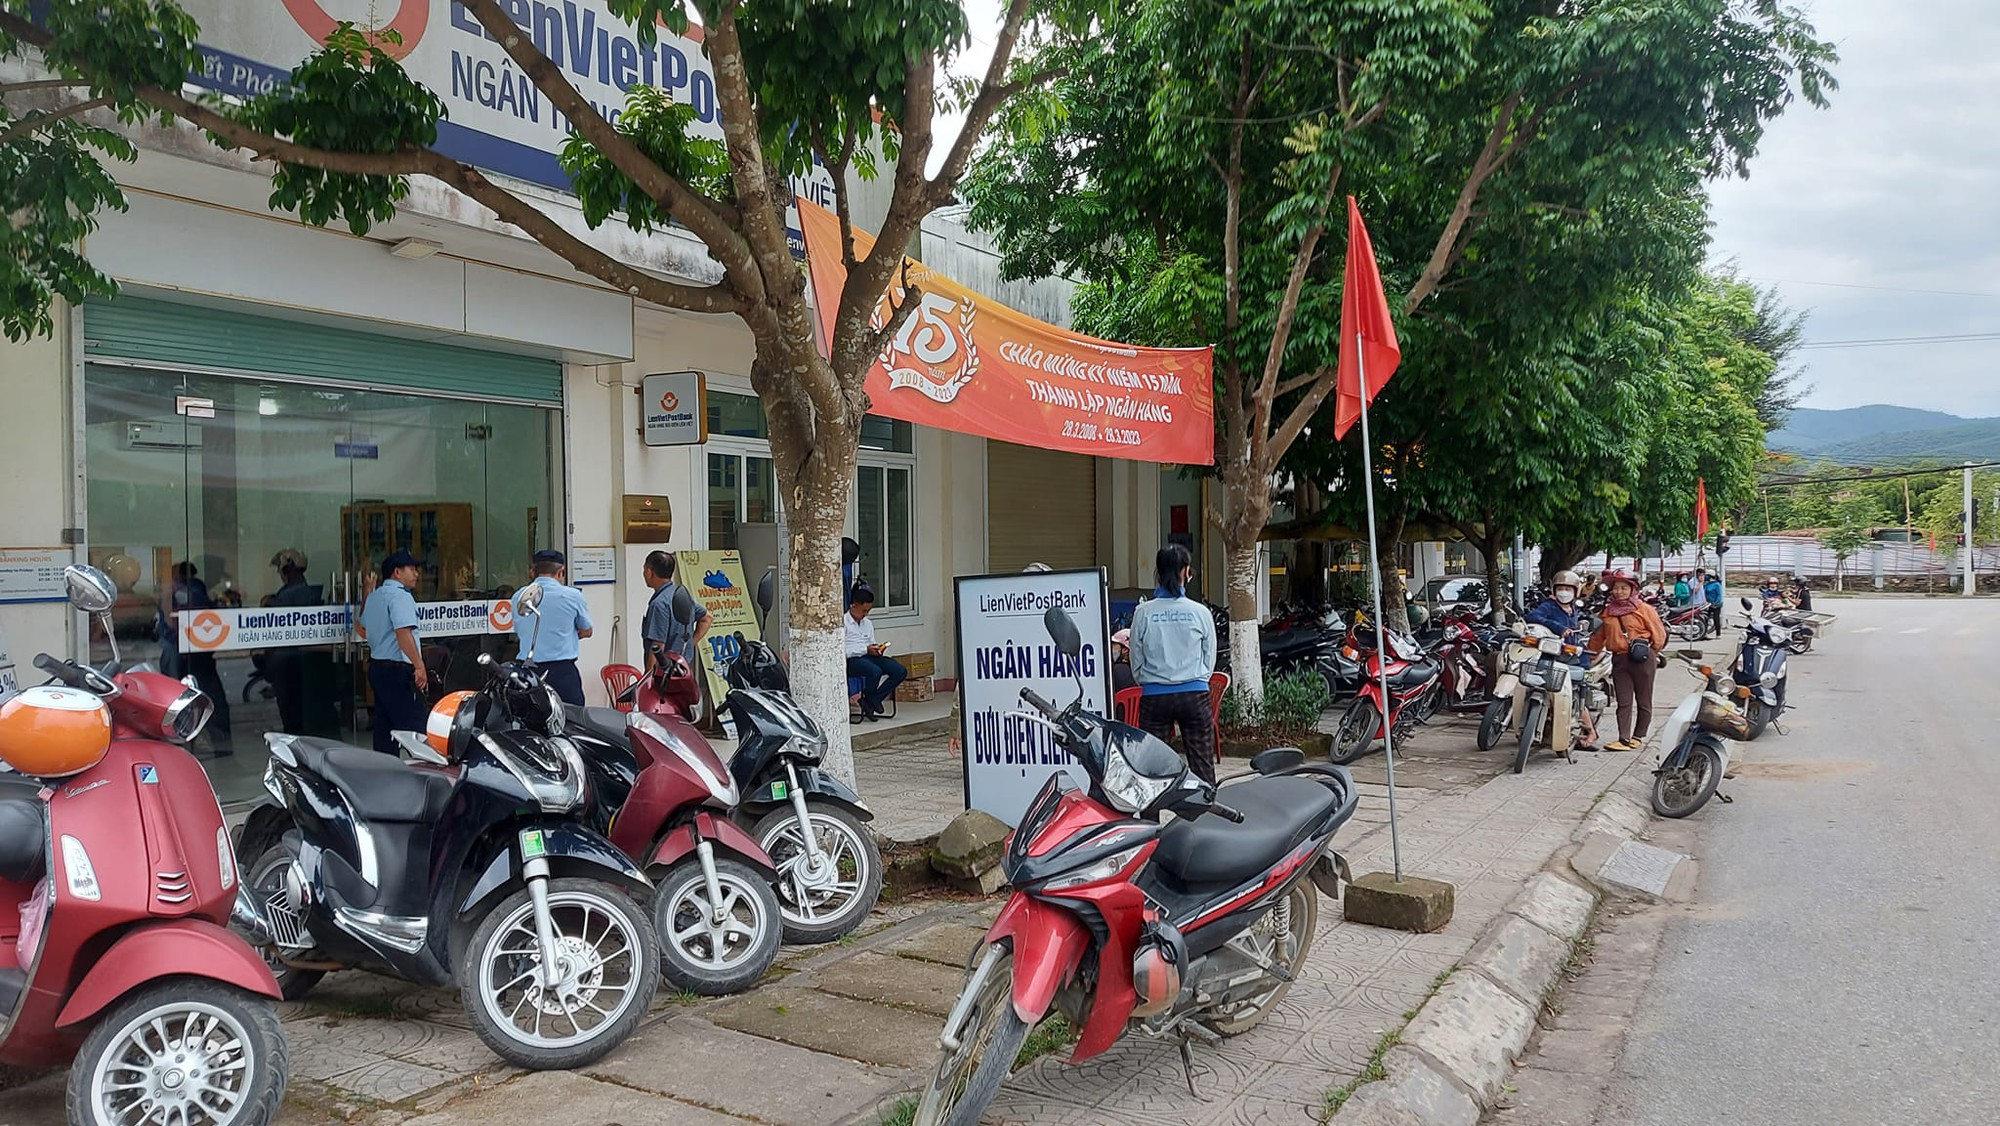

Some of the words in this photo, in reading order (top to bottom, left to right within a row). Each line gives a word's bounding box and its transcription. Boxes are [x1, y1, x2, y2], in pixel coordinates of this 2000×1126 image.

[451, 49, 540, 124] NGÂN
[898, 372, 925, 388] 2008
[933, 384, 954, 401] 2023
[998, 340, 1041, 371] CHÀO
[1042, 352, 1087, 381] MỪNG
[1106, 366, 1145, 393] NIỆM
[1141, 373, 1160, 392] 15
[1025, 378, 1080, 409] THÀNH
[1080, 391, 1105, 418] LẬP
[1104, 395, 1136, 421] NGÂN
[1134, 400, 1174, 424] HÀNG
[416, 603, 489, 621] VietPostBank
[980, 589, 1087, 613] LienVietPostBank
[1151, 610, 1196, 623] adidas
[975, 639, 1033, 681] NGÂN
[973, 705, 1002, 766] BƯU
[1003, 698, 1038, 778] ĐIỆN
